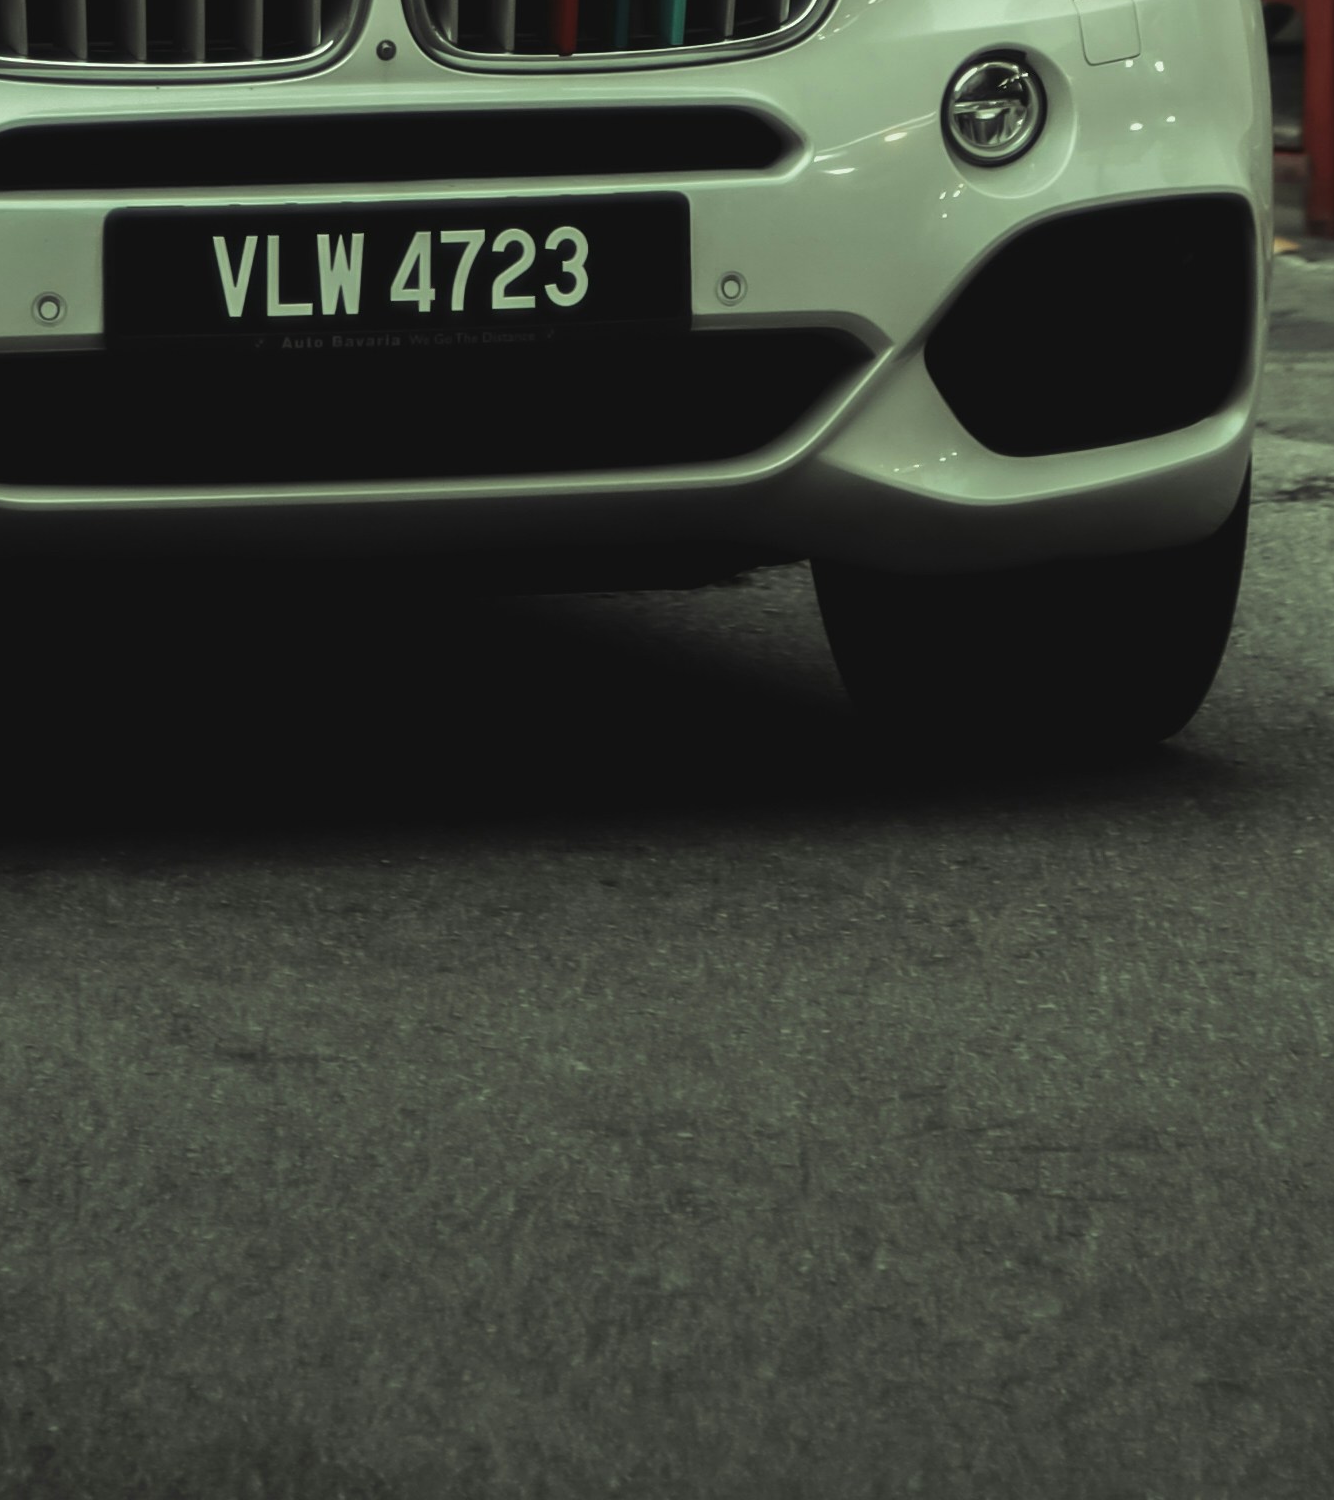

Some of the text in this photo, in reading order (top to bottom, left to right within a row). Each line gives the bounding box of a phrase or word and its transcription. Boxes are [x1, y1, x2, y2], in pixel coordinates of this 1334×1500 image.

[212, 225, 589, 318] VLW 4723
[281, 330, 536, 350] Auto Bavaria We Go The Distance
